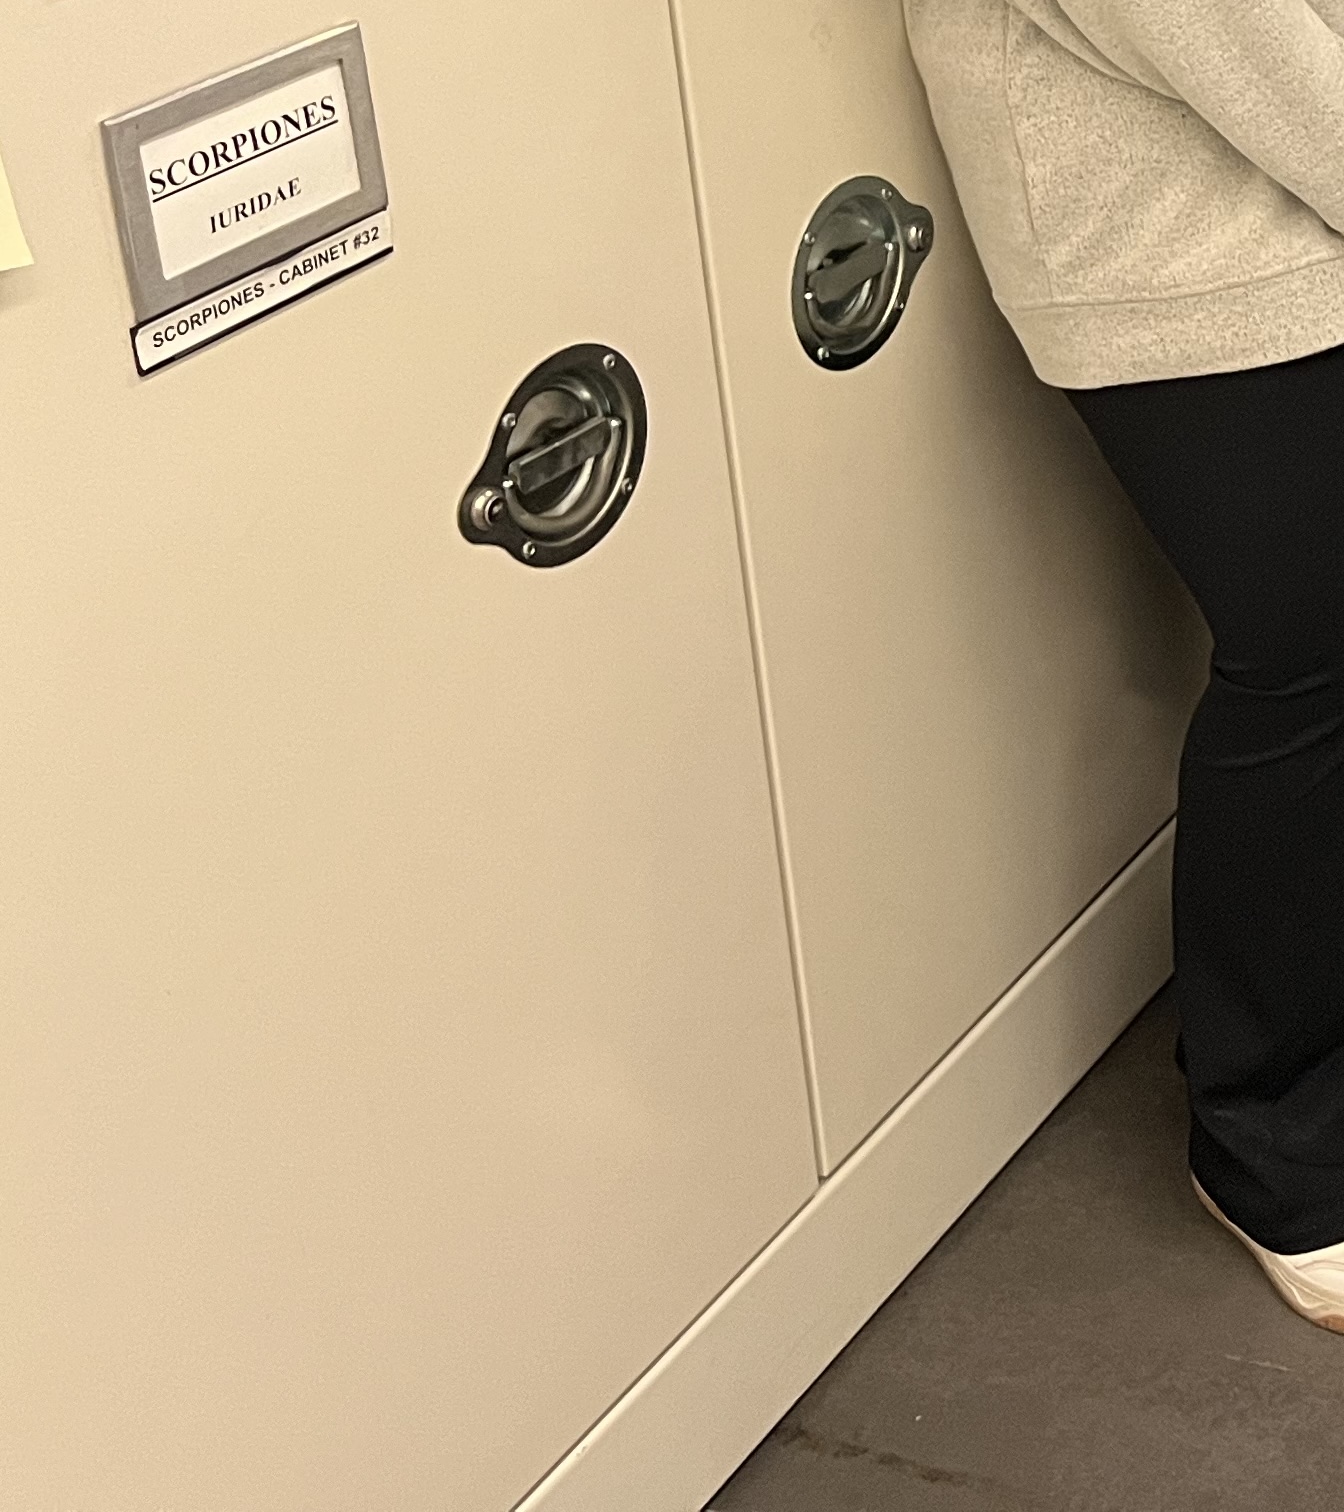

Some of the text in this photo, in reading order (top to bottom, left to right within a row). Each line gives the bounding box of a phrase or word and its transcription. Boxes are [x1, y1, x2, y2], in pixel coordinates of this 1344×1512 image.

[148, 94, 337, 197] SCORPIONES
[210, 176, 303, 234] IURIDAE
[152, 281, 265, 348] SCORPIONES
[278, 240, 348, 285] CABINET
[352, 226, 380, 250] #32
